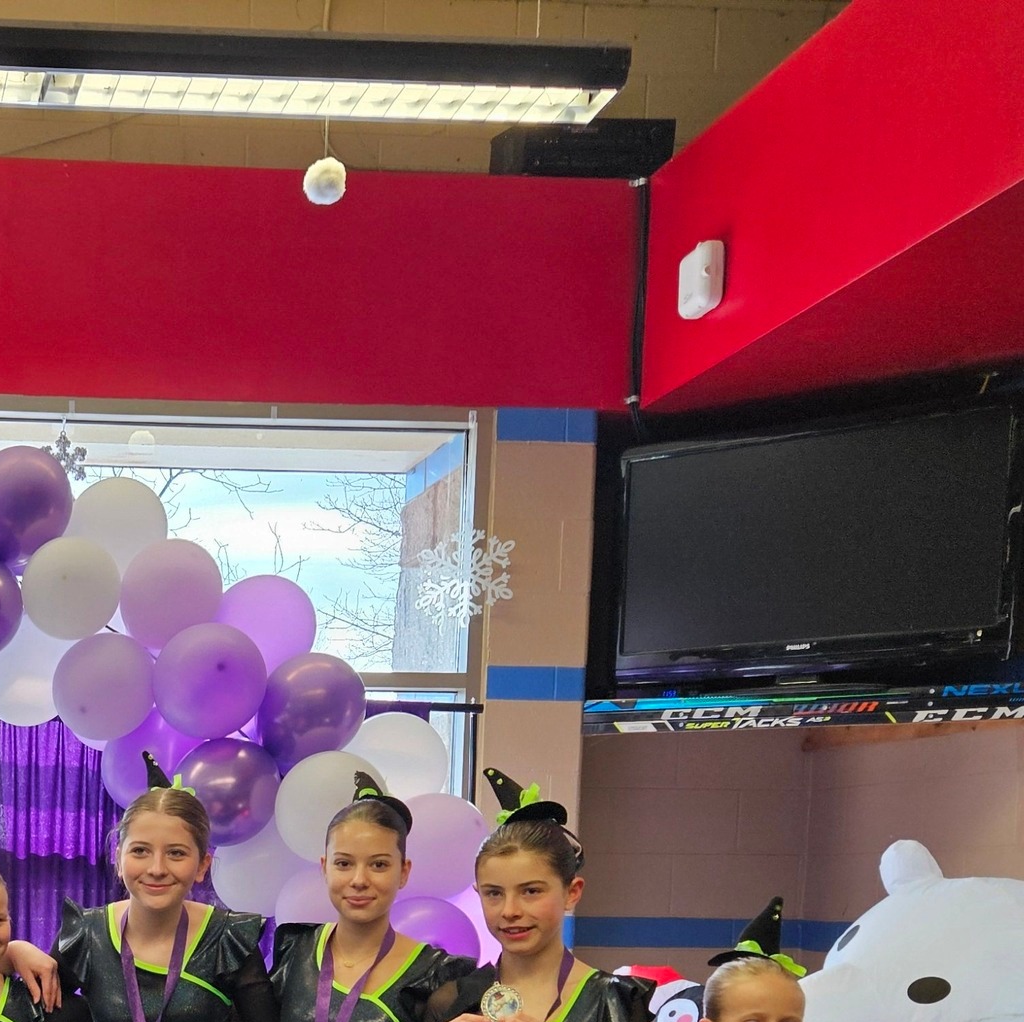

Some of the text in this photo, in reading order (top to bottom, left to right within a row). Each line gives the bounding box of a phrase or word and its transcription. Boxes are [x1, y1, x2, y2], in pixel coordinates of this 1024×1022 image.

[660, 705, 763, 719] CCM
[685, 721, 731, 730] SUPER
[731, 716, 804, 730] TACKS
